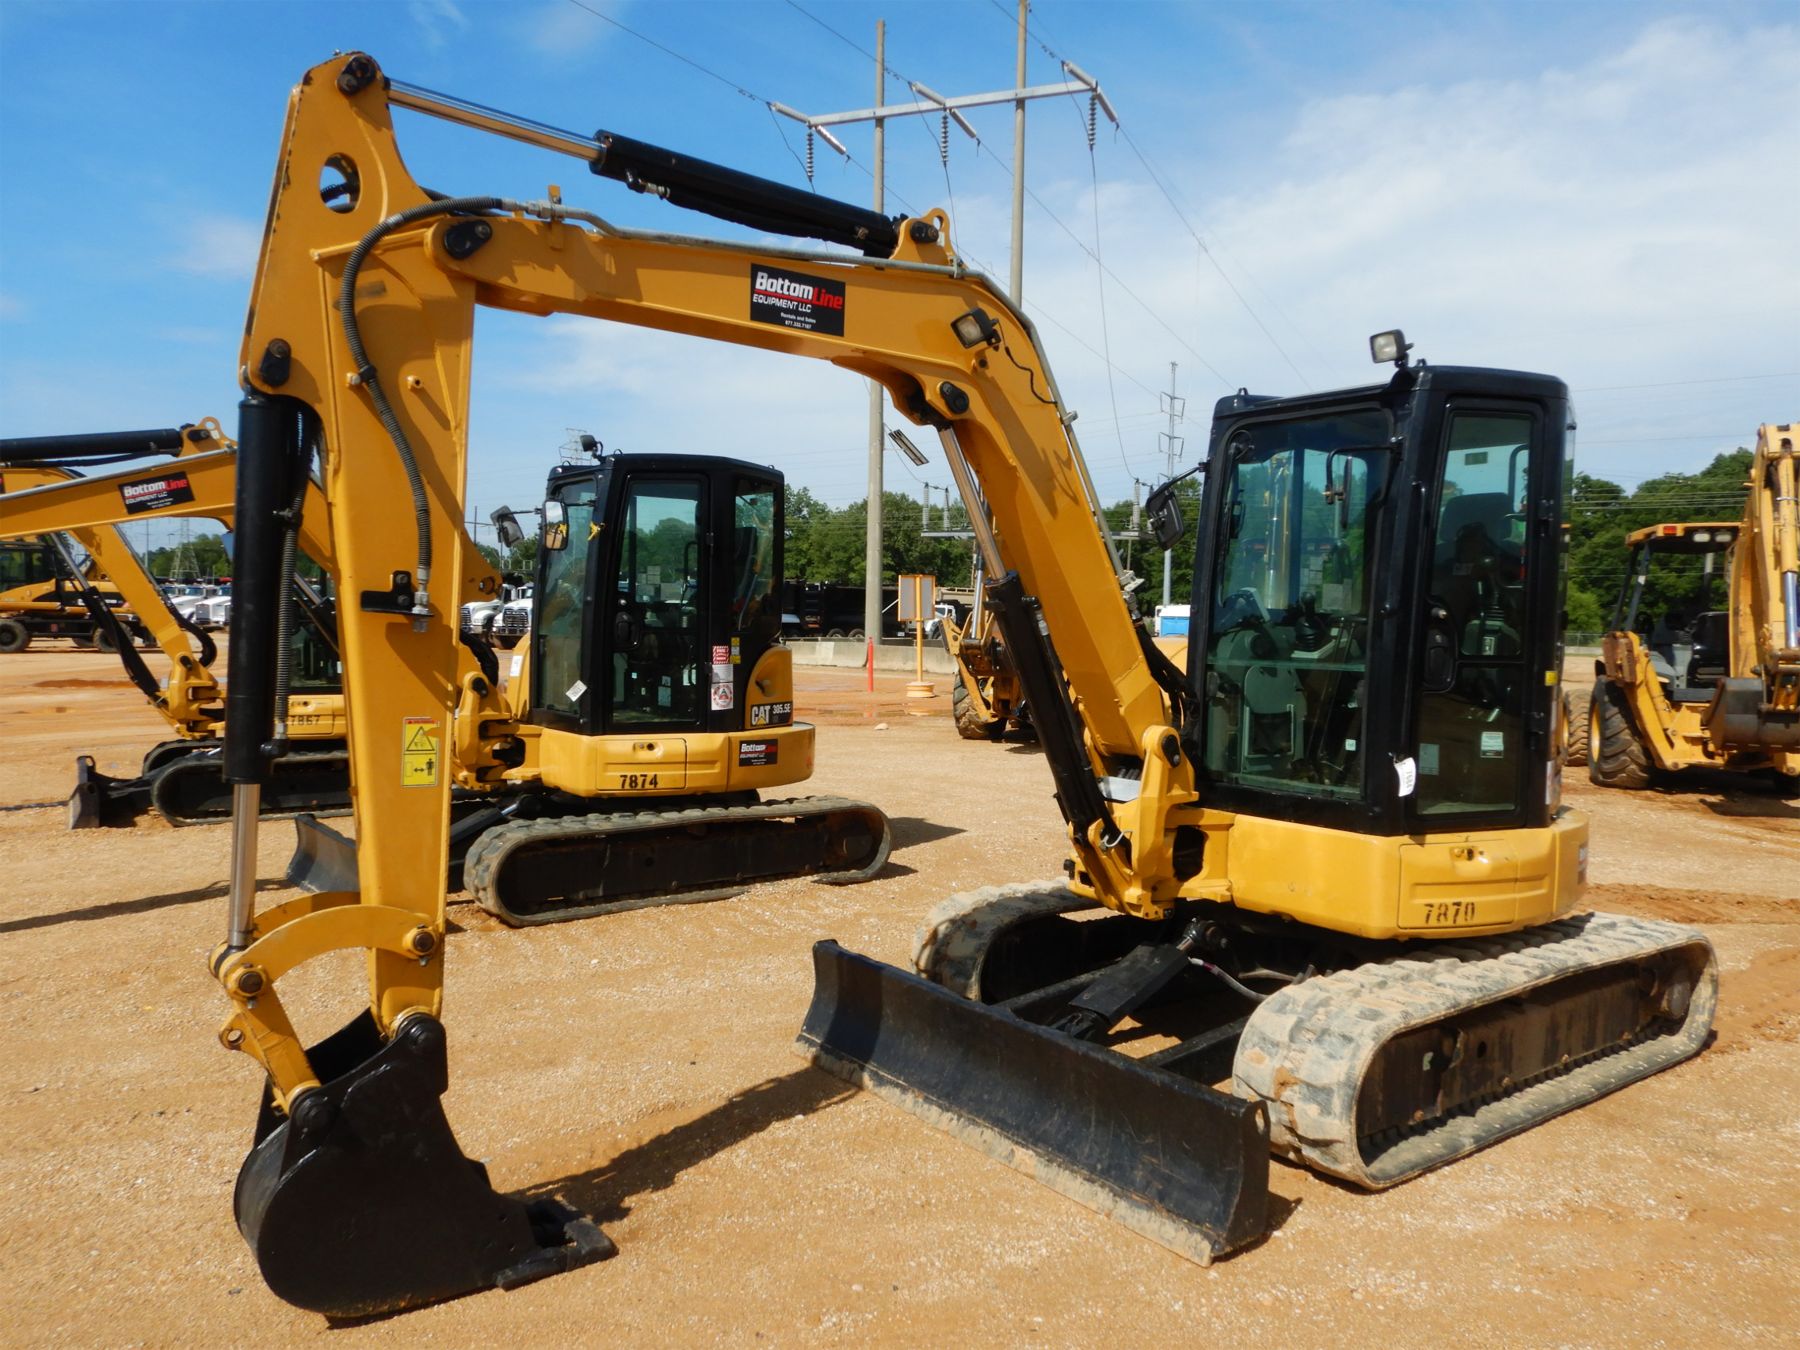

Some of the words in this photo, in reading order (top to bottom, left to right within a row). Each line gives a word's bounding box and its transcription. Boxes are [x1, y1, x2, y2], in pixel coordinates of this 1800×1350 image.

[755, 271, 843, 309] BottomLine
[752, 293, 798, 310] EQUIPMENT
[798, 303, 812, 313] LLC
[123, 479, 188, 497] BottomLine
[751, 705, 770, 726] CAT
[620, 774, 658, 789] 7874
[1424, 902, 1475, 924] 7870
